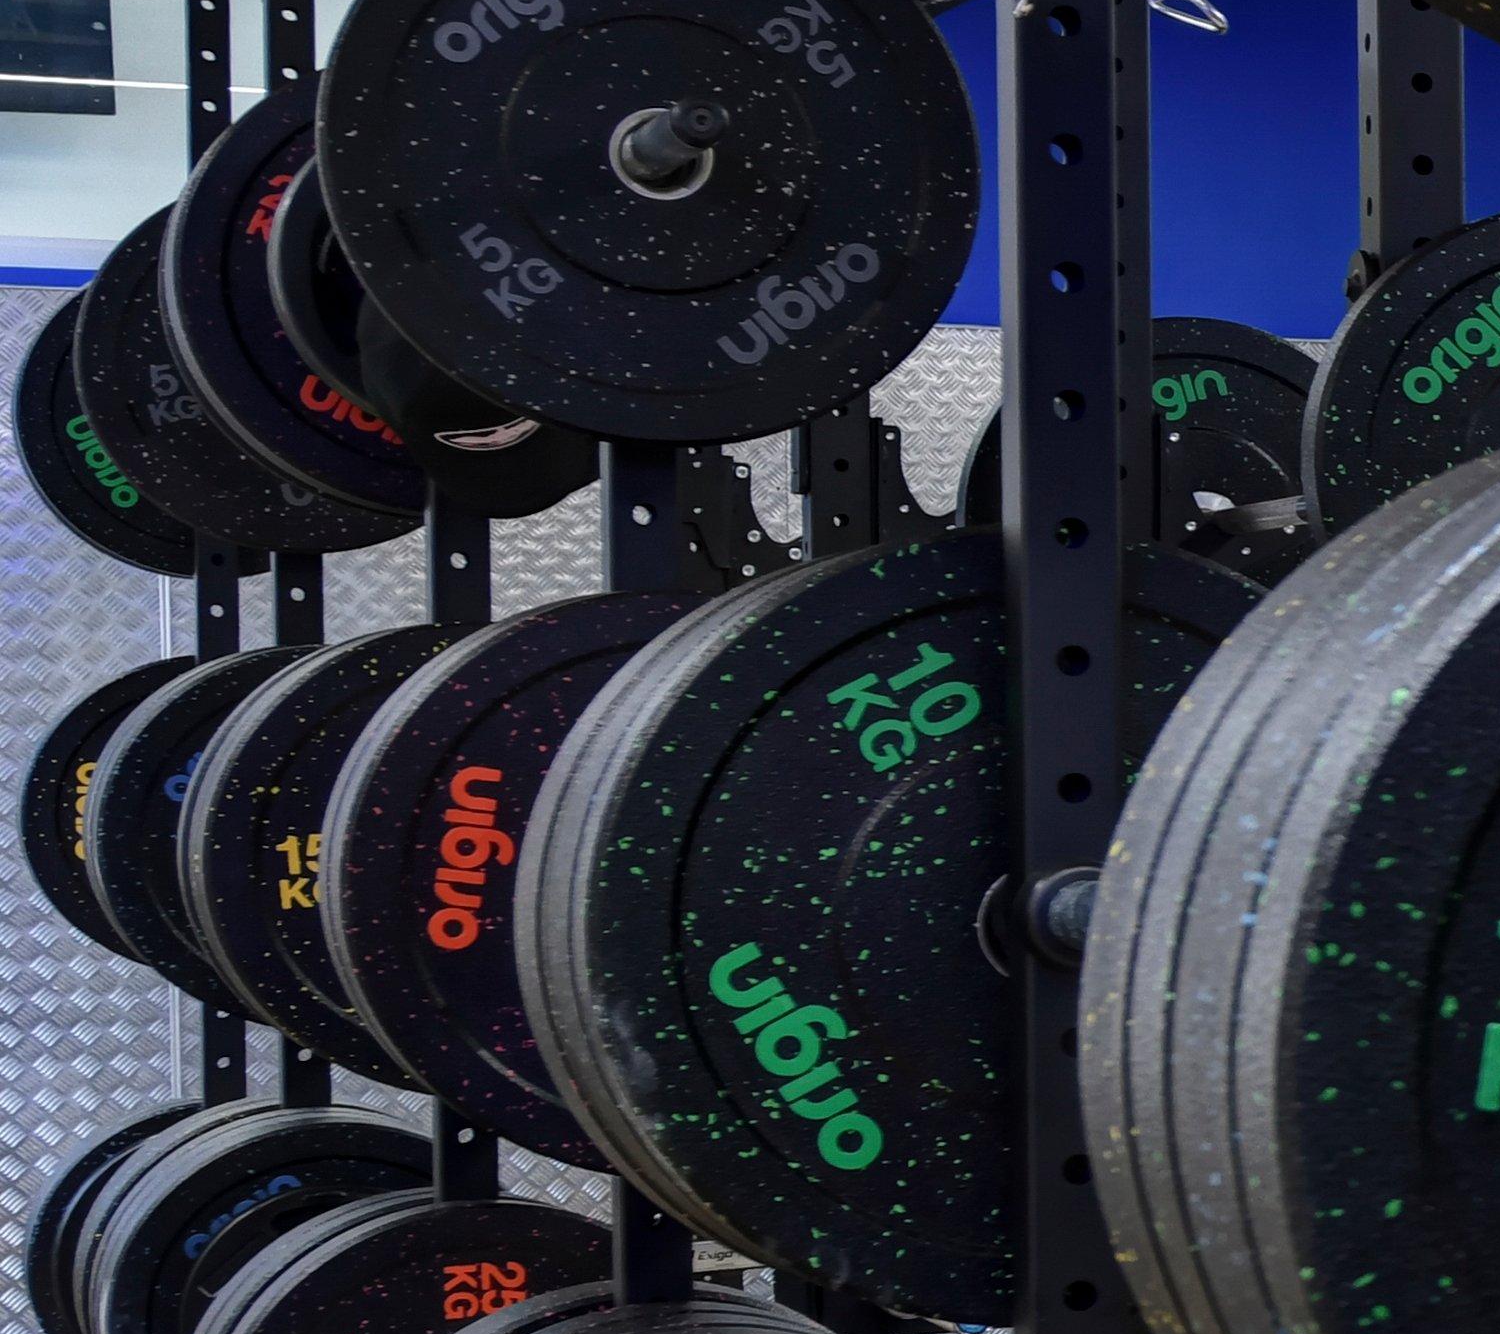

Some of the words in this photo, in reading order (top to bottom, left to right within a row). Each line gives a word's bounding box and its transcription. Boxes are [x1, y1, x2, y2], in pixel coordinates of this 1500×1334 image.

[805, 40, 858, 89] 5
[459, 223, 512, 273] 5
[484, 261, 564, 321] KG
[717, 243, 881, 364] origin
[150, 364, 178, 397] 5
[883, 642, 981, 737] 10
[827, 672, 918, 773] KG
[428, 765, 514, 951] origin
[707, 943, 883, 1169] origin
[443, 1264, 479, 1320] KG
[481, 1261, 526, 1315] 25
